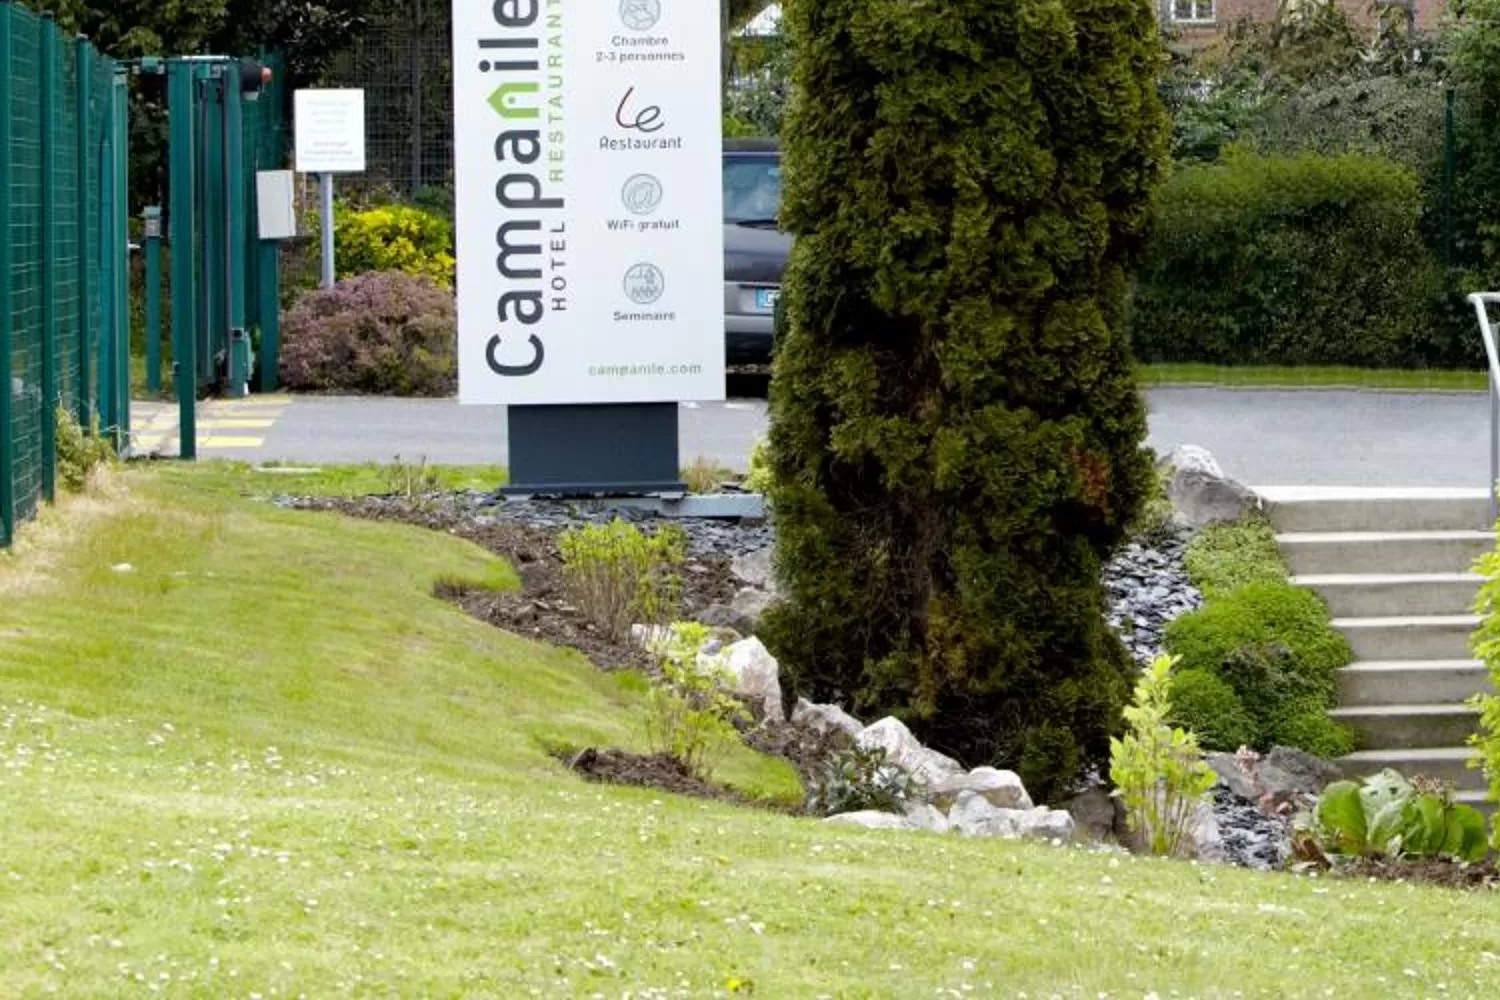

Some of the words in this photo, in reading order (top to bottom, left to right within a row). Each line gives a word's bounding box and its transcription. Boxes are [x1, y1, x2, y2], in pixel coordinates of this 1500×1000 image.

[611, 35, 669, 47] Chambre
[619, 51, 685, 63] personnes
[615, 86, 665, 133] Le
[599, 137, 682, 150] Restaurant
[637, 219, 680, 232] gratuit
[549, 221, 567, 311] HOTEL
[588, 362, 702, 377] campanile.com
